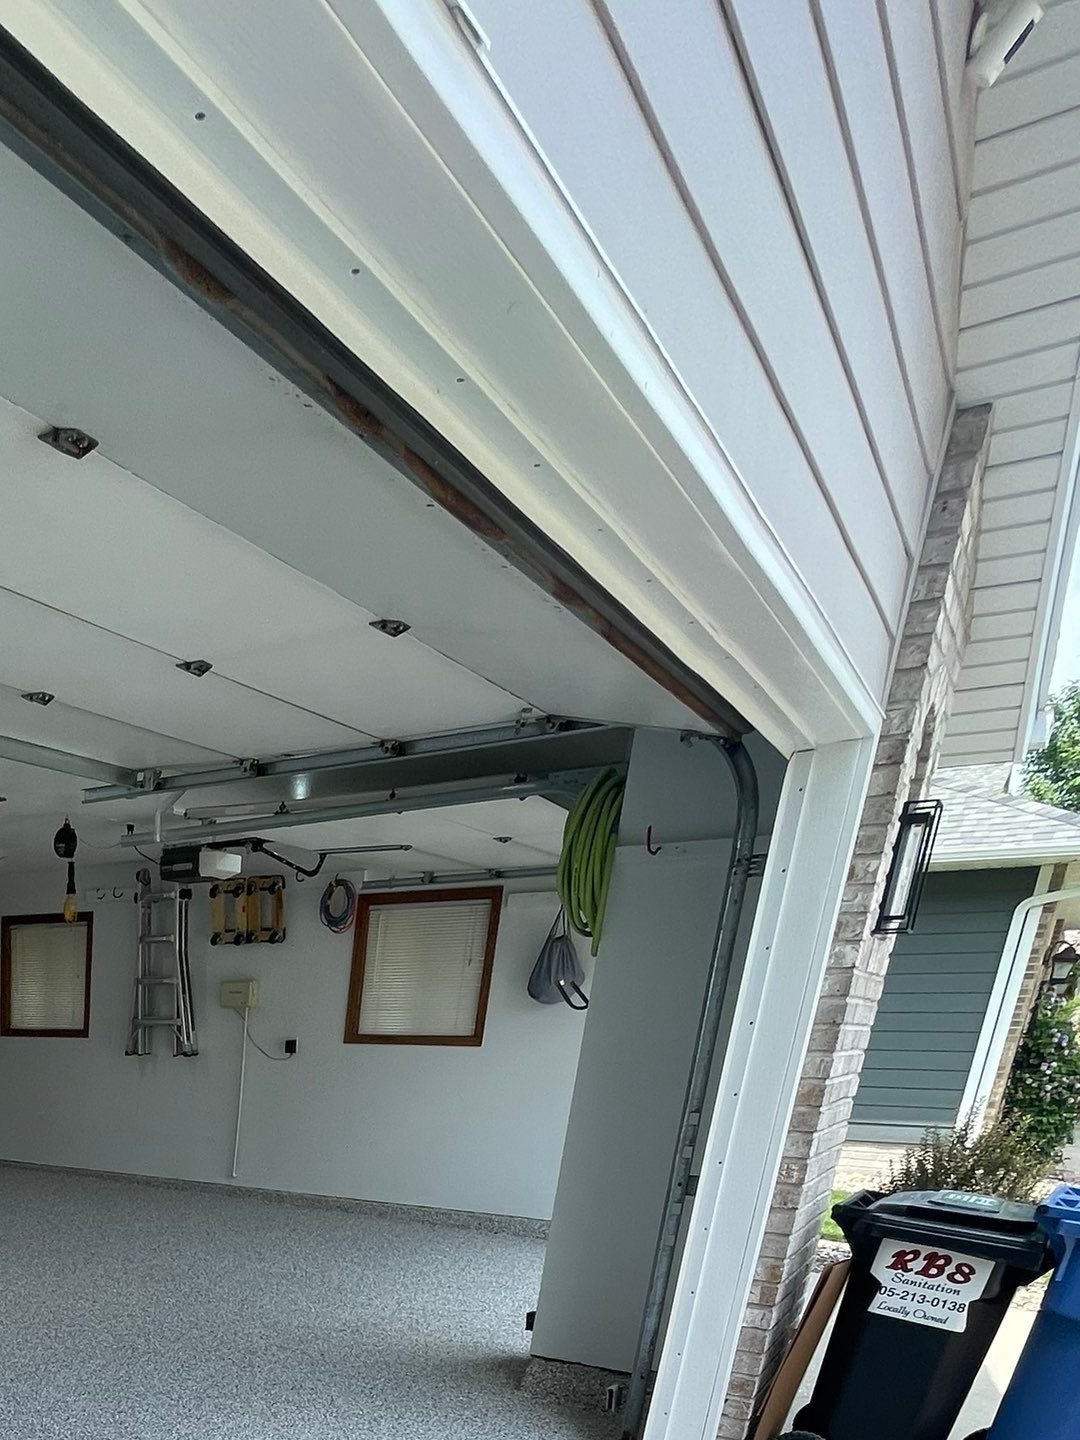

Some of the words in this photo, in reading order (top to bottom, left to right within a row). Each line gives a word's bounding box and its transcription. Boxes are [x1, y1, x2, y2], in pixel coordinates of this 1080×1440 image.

[891, 1272, 961, 1296] Sanitation
[877, 1301, 910, 1317] Locally
[913, 1309, 950, 1325] Owned
